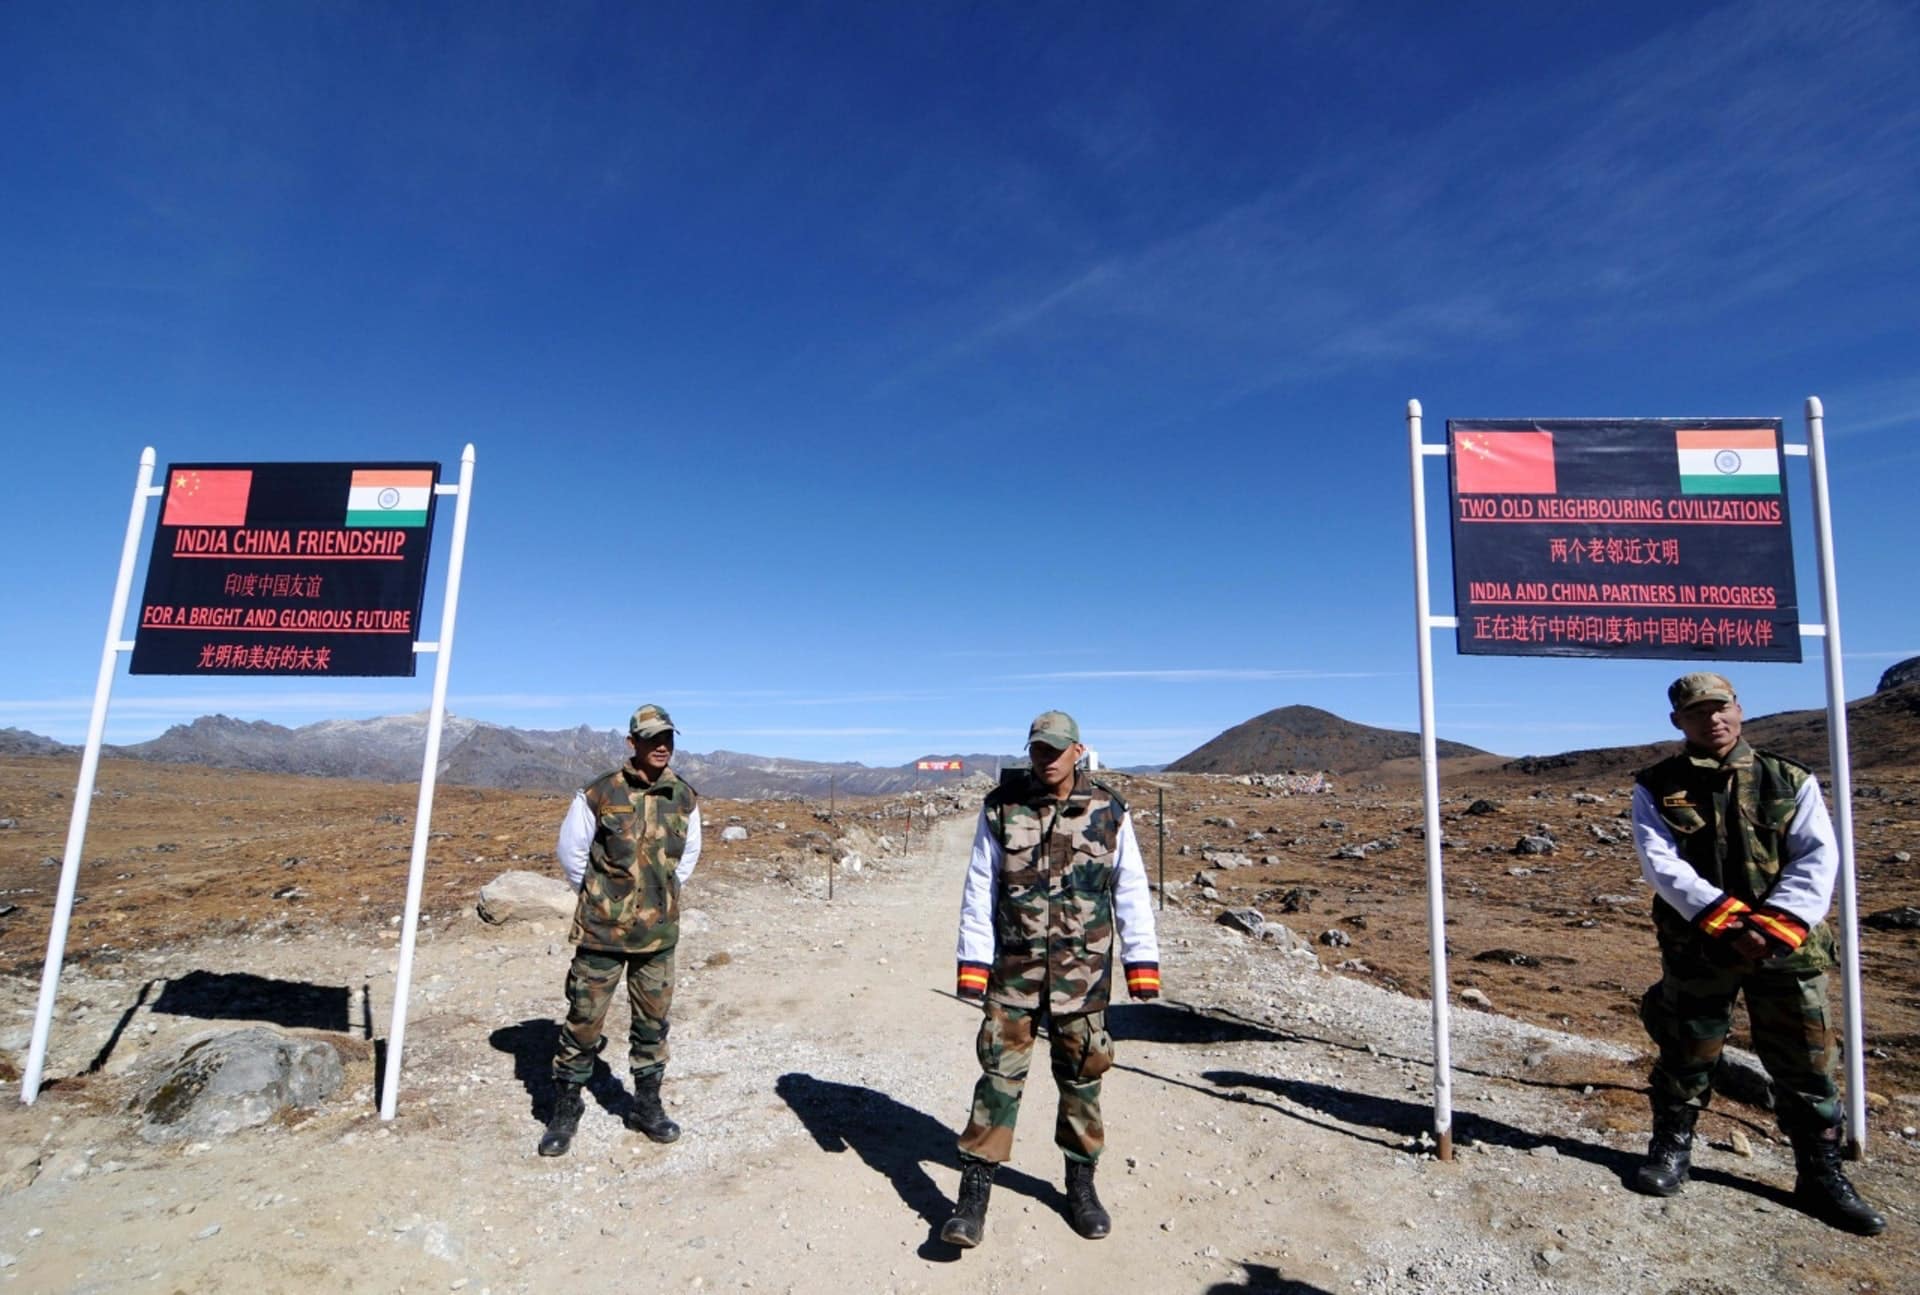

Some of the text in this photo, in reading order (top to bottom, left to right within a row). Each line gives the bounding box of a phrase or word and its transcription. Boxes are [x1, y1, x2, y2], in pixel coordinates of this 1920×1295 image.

[1459, 498, 1780, 521] TWO OLD NEIGHBOURING CIVILIZATIONS
[175, 529, 406, 555] INDIA CHINA FRIENDSHIP
[1550, 538, 1680, 566] 两个老邻近文明
[224, 572, 323, 598] 印度中国友谊
[1470, 583, 1776, 605] INDIA AND CHINA PARTNERS IN PROGRESS
[143, 606, 410, 629] FOR A BRIGHT AND GLORIOUS FUTURE
[1474, 615, 1774, 647] 正在进行中的印度和中国的合作伙伴
[197, 644, 331, 671] 光明和美好的未来
